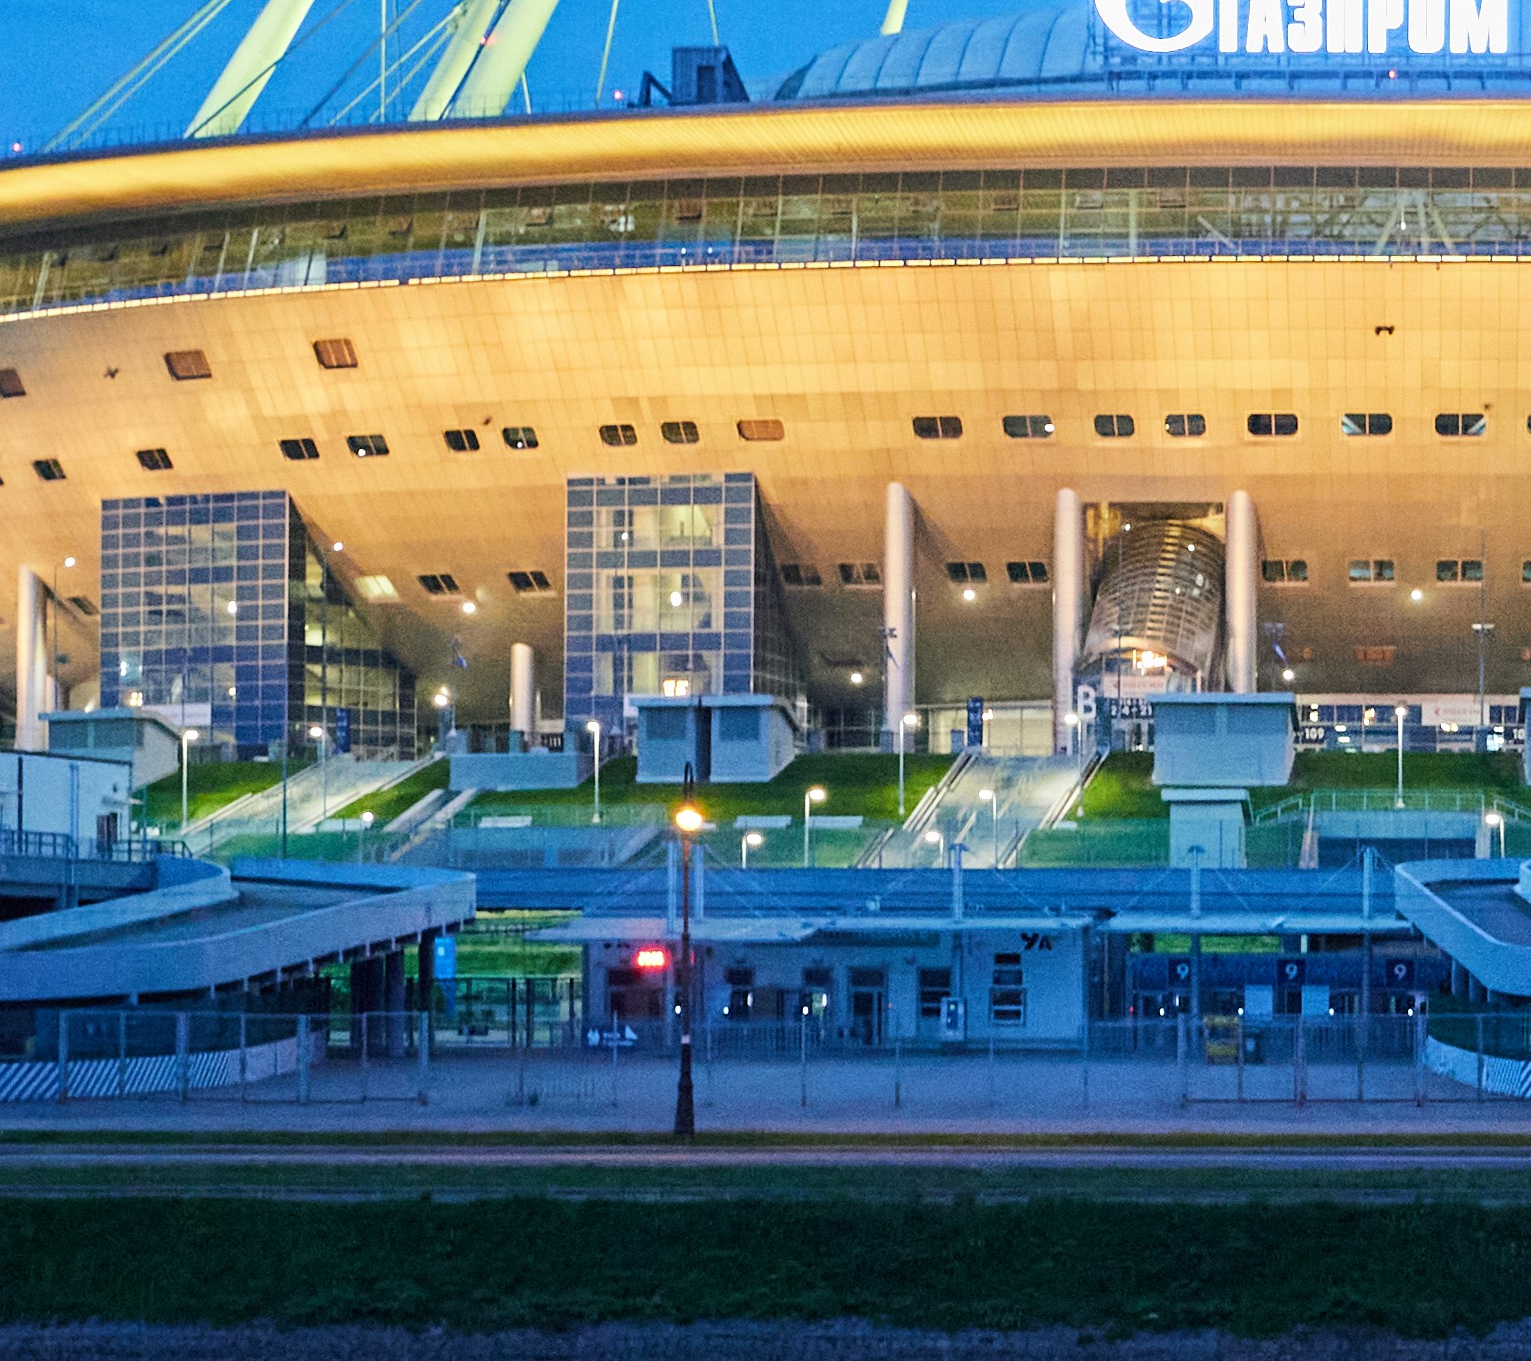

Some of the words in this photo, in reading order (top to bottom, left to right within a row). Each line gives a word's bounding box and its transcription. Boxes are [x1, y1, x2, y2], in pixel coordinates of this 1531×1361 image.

[1304, 727, 1325, 740] 109
[1176, 962, 1189, 980] 9
[1285, 962, 1298, 980] 9
[1394, 963, 1407, 980] 9
